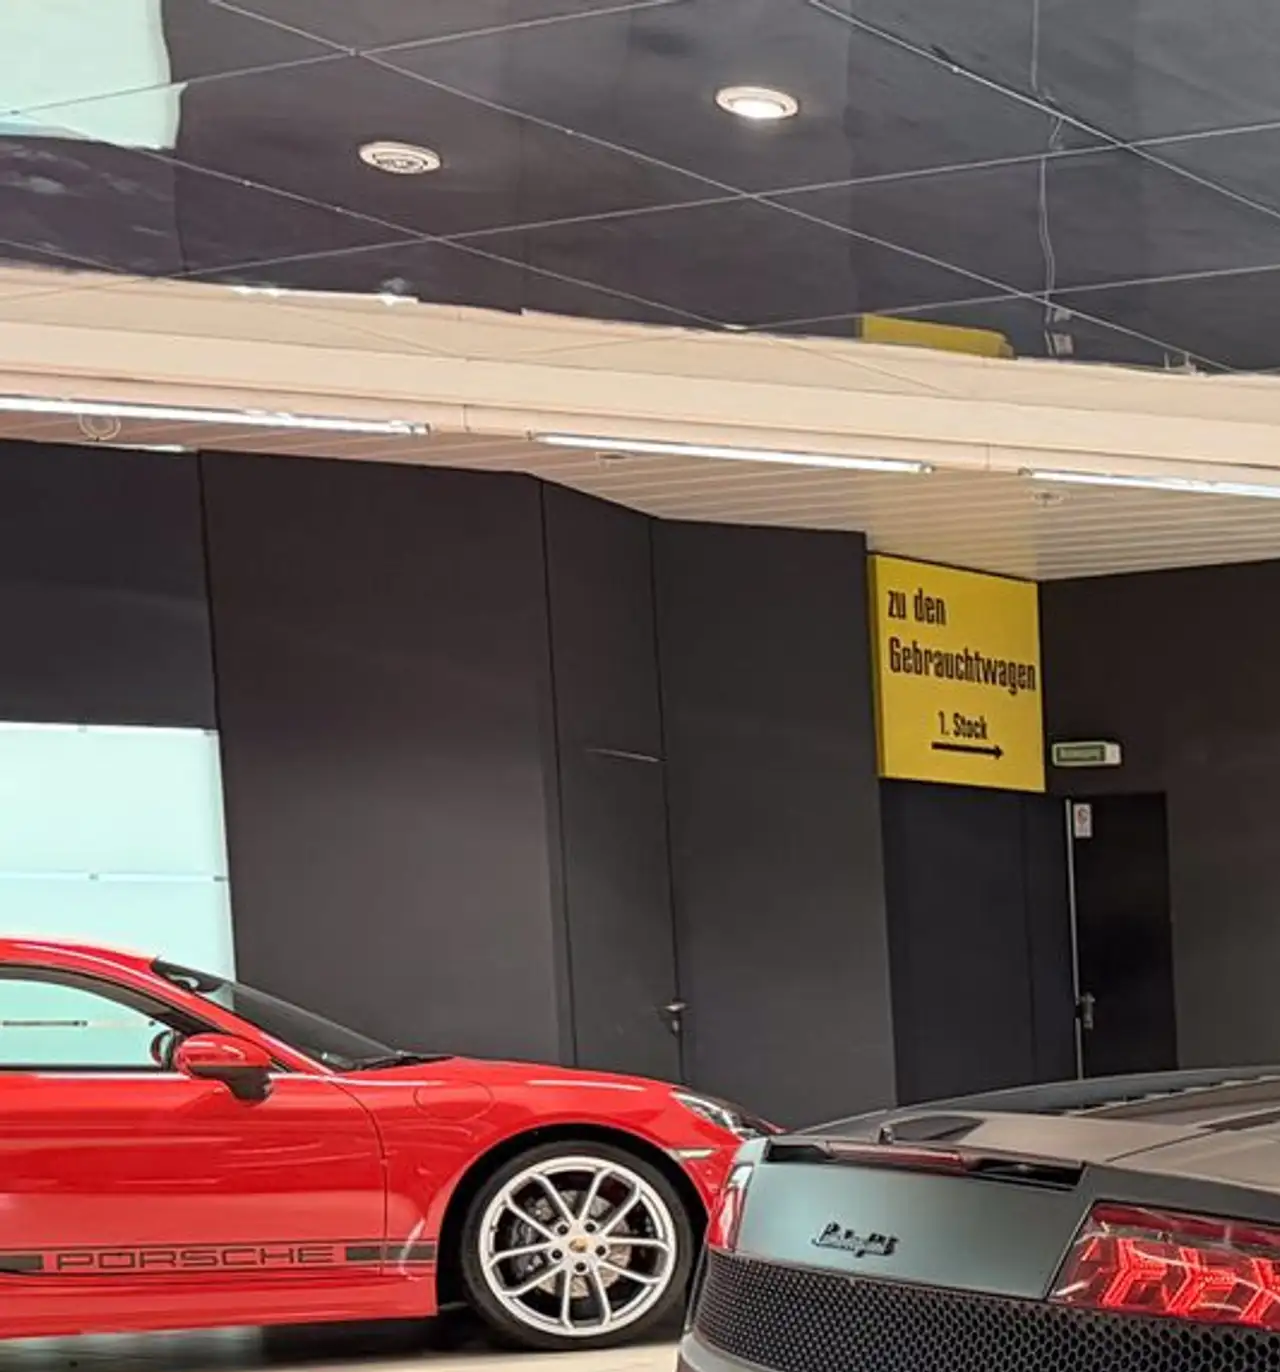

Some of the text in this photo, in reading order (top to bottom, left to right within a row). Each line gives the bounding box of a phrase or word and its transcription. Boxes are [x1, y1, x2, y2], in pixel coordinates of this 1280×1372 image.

[888, 588, 946, 625] zu den
[889, 637, 1036, 695] Gebrauchtwagen
[938, 710, 987, 739] 1. Stock
[58, 1247, 333, 1270] PORSCHE
